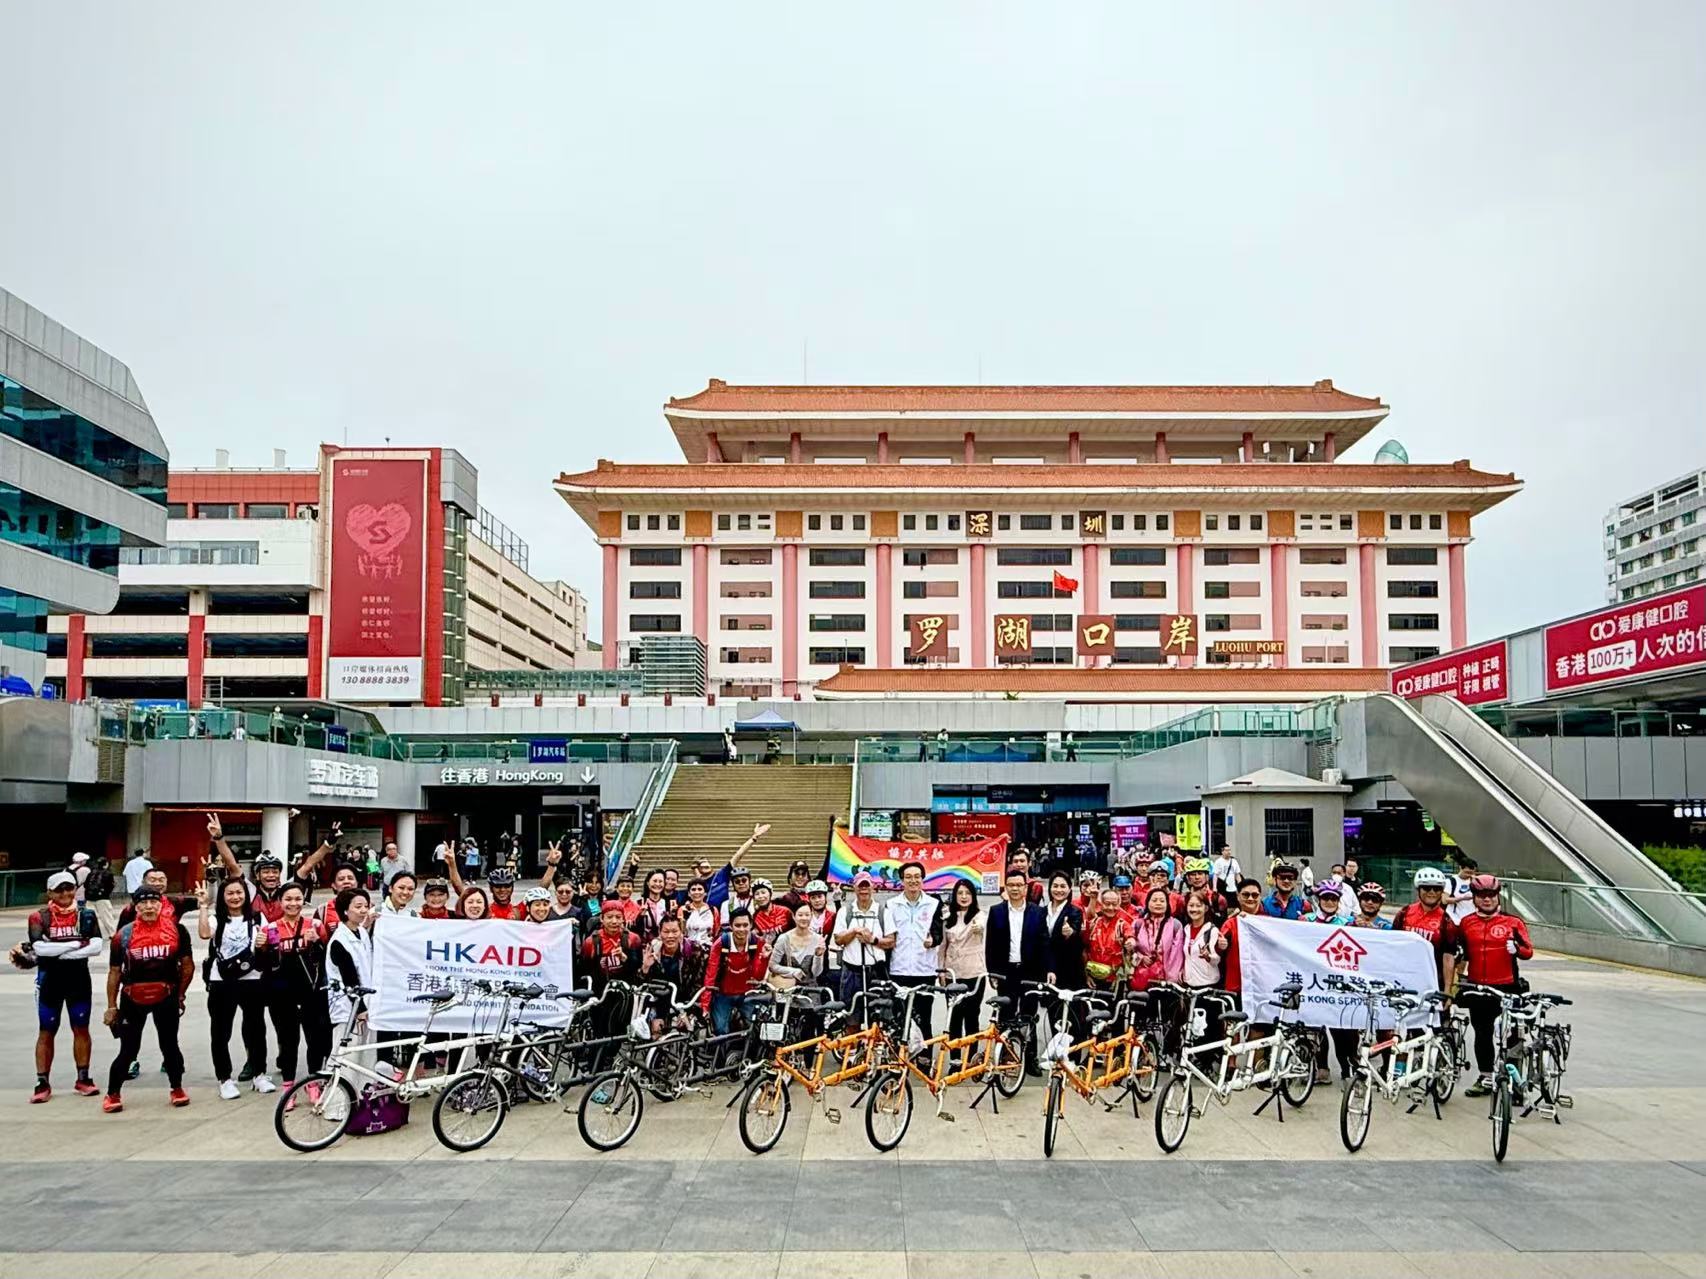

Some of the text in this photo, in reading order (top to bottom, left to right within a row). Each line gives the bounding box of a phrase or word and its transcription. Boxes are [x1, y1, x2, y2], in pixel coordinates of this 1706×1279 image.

[1618, 600, 1689, 635] 爱康健口腔
[917, 615, 1195, 653] 罗湖口岸
[1215, 643, 1284, 653] LUOHU PORT
[341, 676, 410, 684] 130 8888 3839
[1414, 667, 1458, 692] 爱康健口腔
[441, 767, 564, 784] 往香港 HongKong
[426, 940, 543, 967] HKAID
[1307, 995, 1336, 1004] KONG
[1338, 997, 1379, 1008] SERVIE
